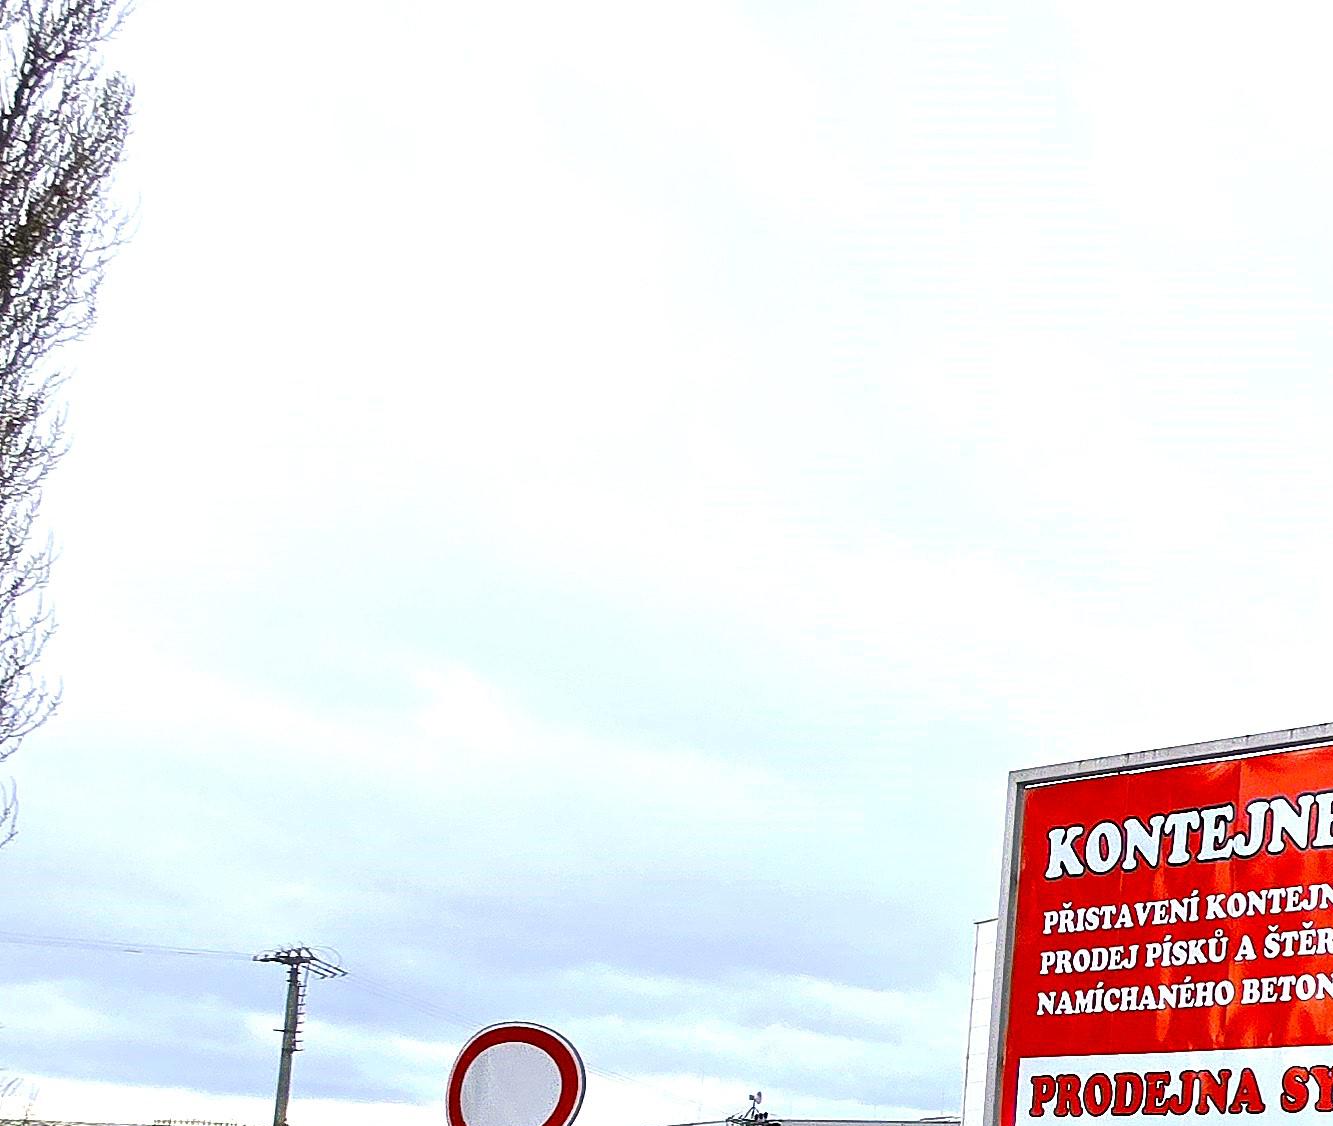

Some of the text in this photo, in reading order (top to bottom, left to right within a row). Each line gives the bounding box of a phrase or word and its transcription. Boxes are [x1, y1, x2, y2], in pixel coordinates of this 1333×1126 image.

[1043, 889, 1199, 936] PŘISTAVENÍ
[1040, 949, 1138, 976] PRODEJ
[1146, 929, 1227, 968] PÍSKŮ
[1235, 938, 1256, 961] A
[1036, 977, 1234, 1017] NAMÍCHANÉHO
[1029, 1068, 1266, 1118] PRODEJNA
